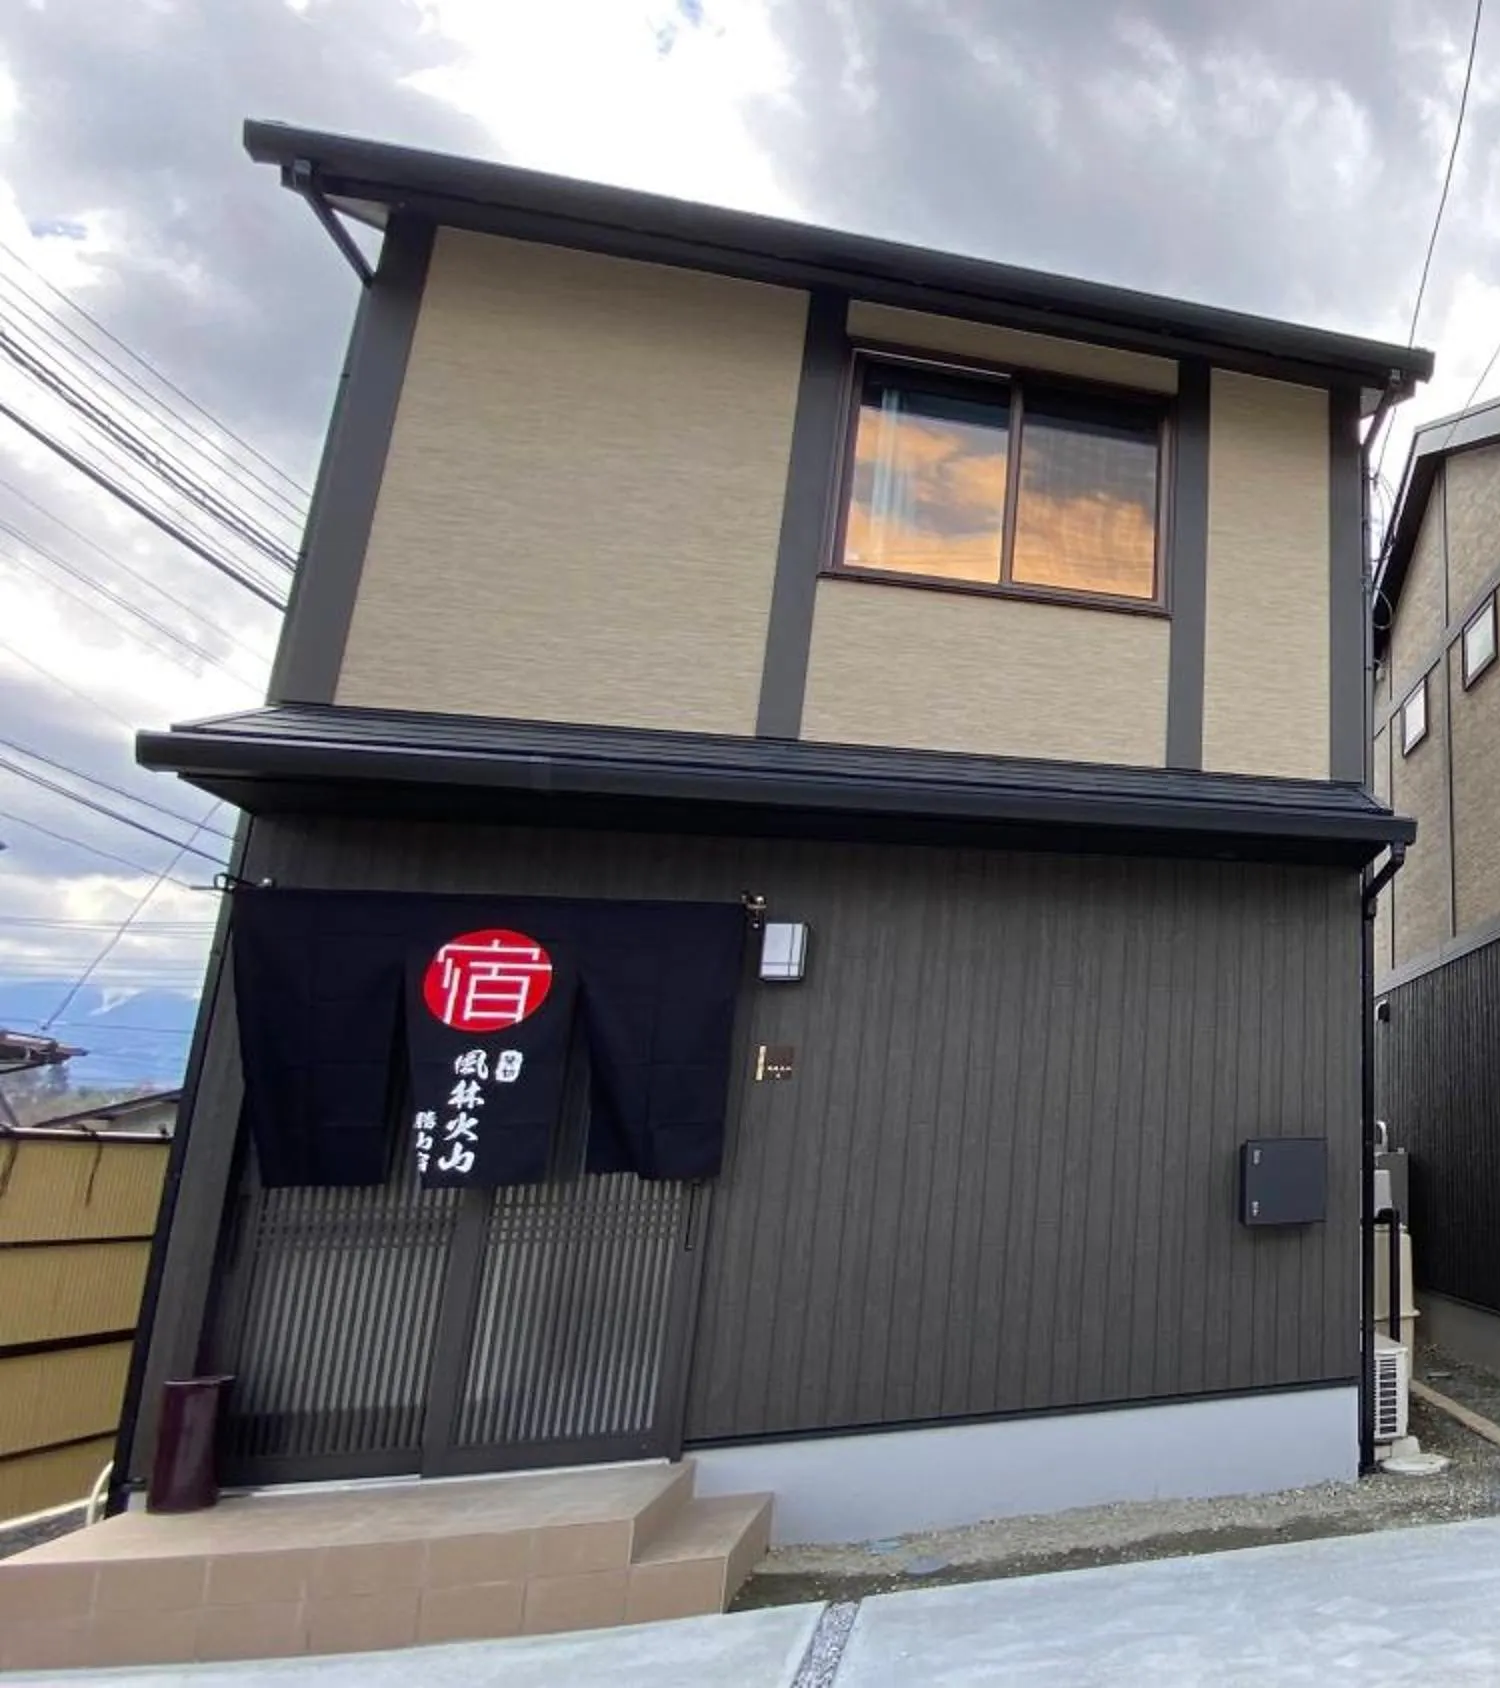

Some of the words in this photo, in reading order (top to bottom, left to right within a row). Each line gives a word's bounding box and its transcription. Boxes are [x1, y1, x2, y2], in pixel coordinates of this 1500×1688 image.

[437, 939, 553, 1025] 宿
[437, 1048, 489, 1173] 風林火山
